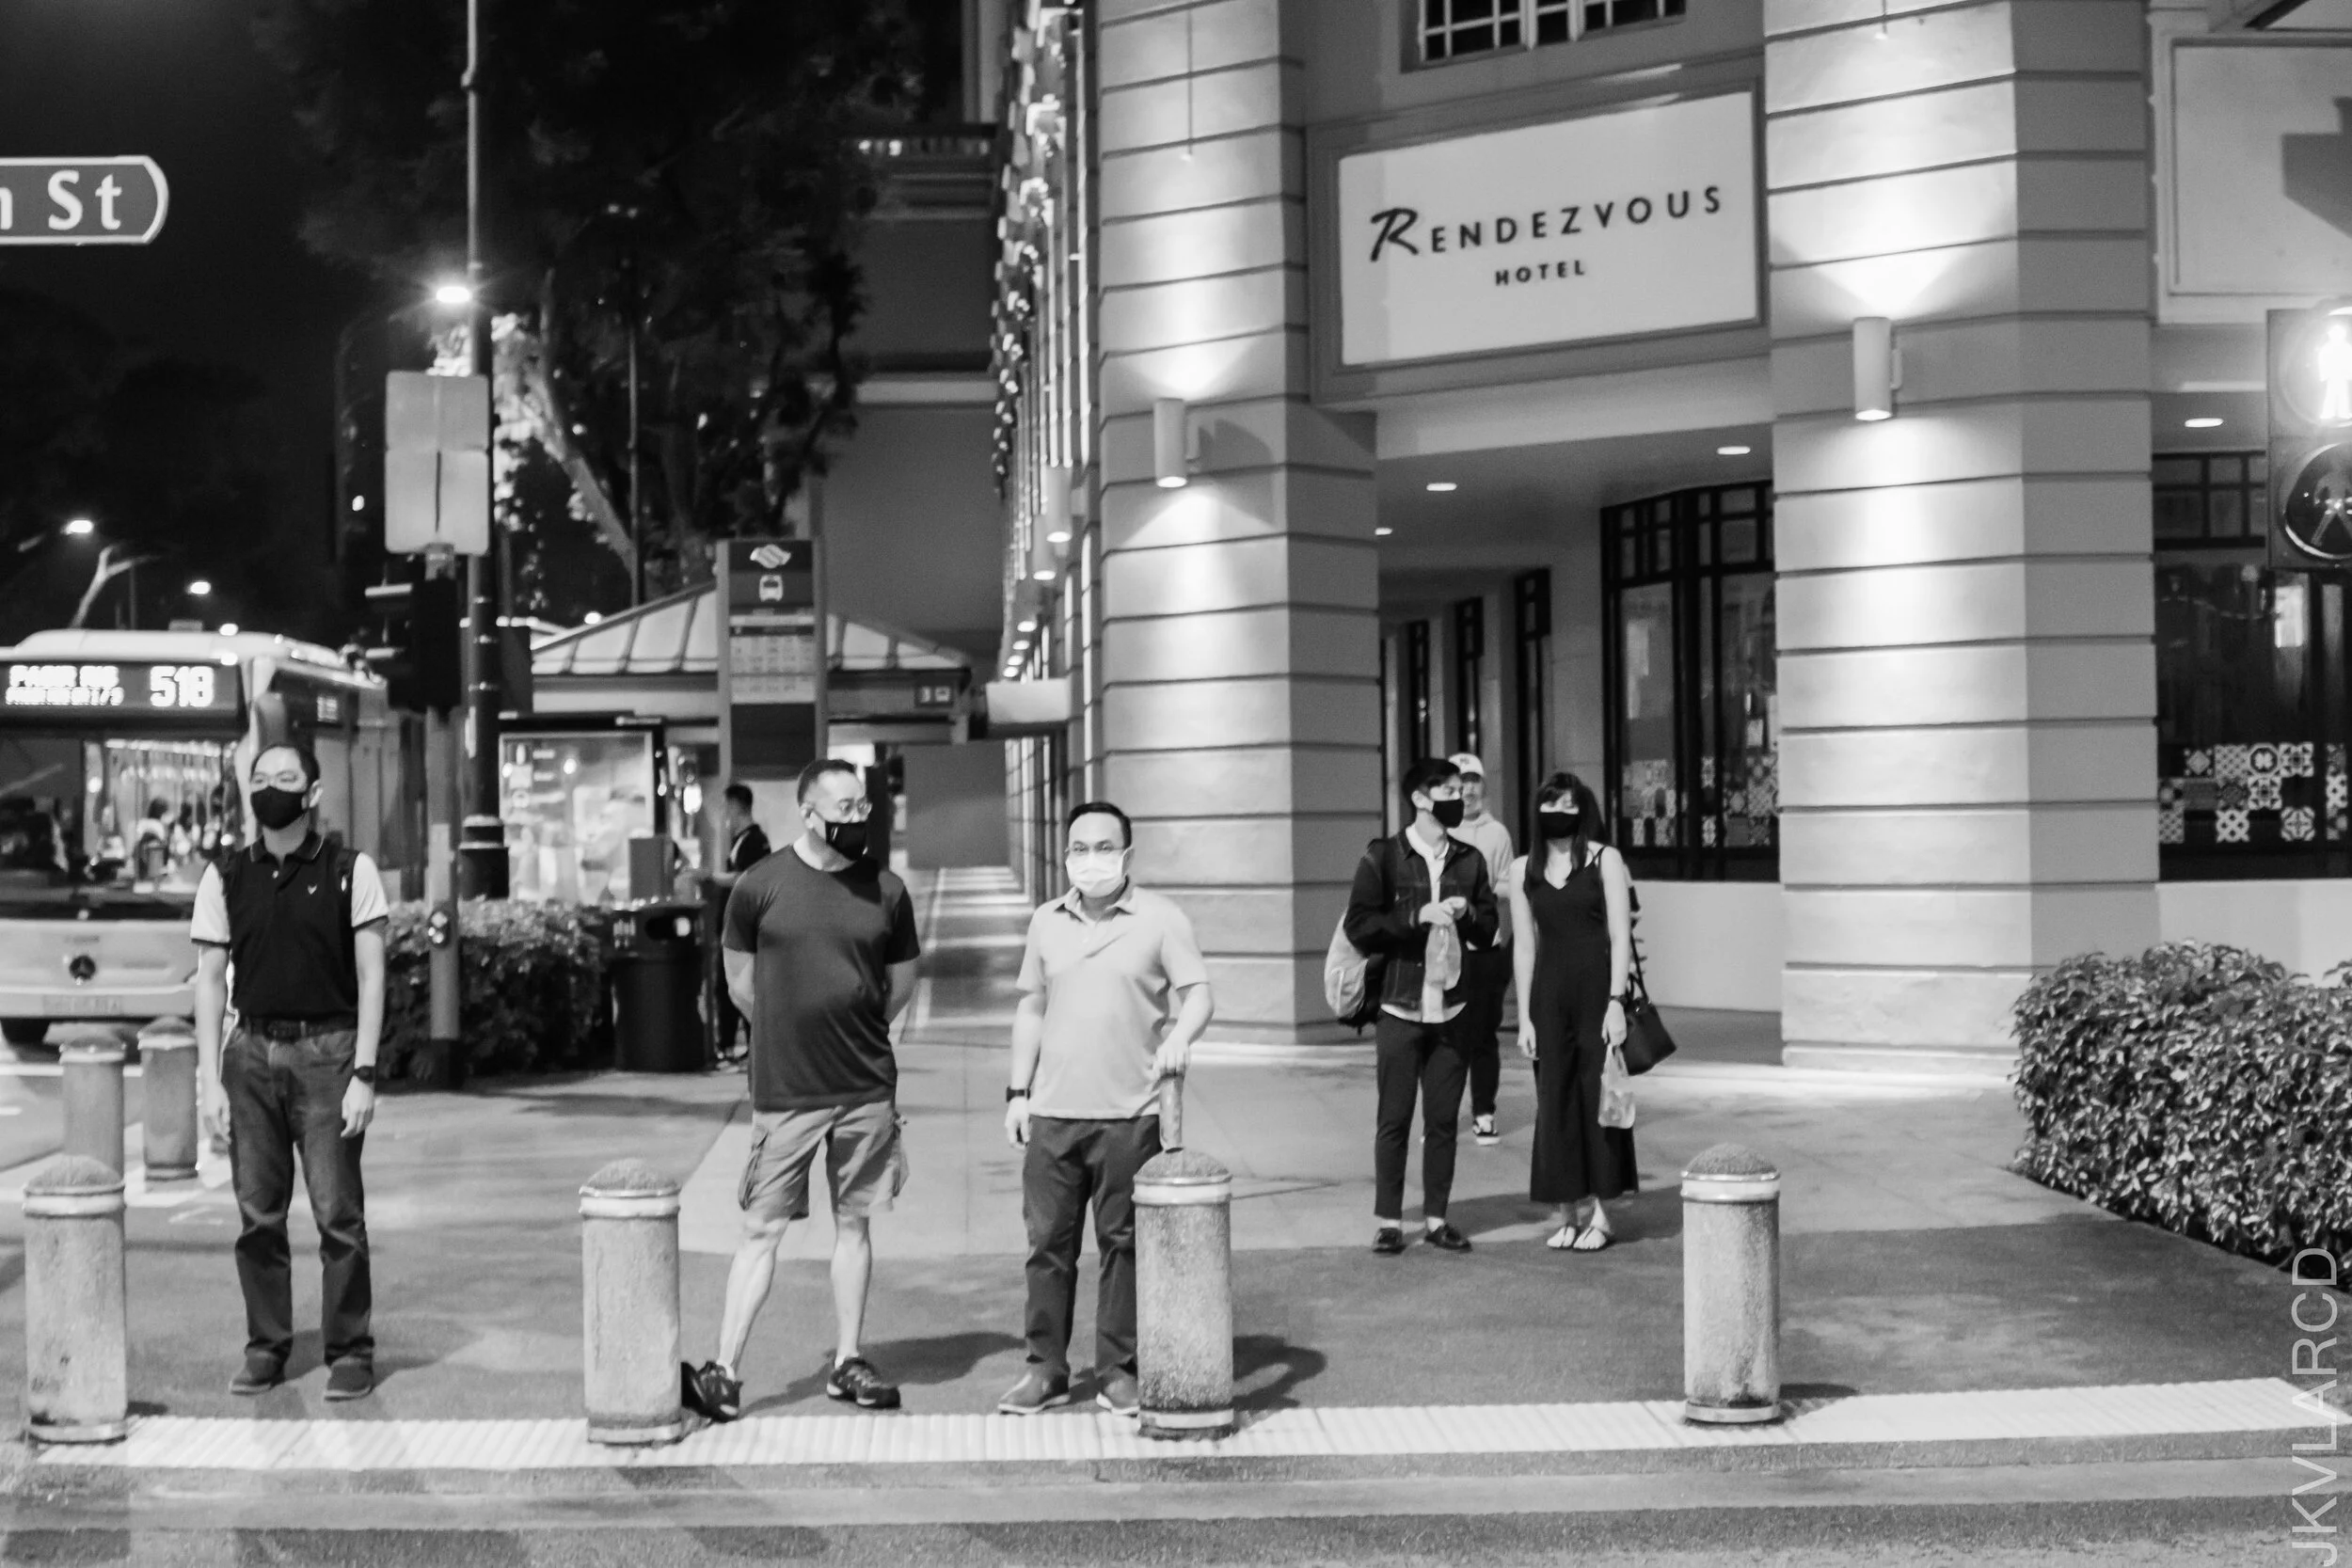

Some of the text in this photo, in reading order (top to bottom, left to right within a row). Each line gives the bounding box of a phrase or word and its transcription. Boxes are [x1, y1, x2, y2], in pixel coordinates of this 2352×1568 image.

[47, 169, 122, 230] St
[1370, 185, 1721, 261] RENDEZVOUS
[1495, 260, 1585, 286] HOTEL
[150, 666, 214, 707] 518
